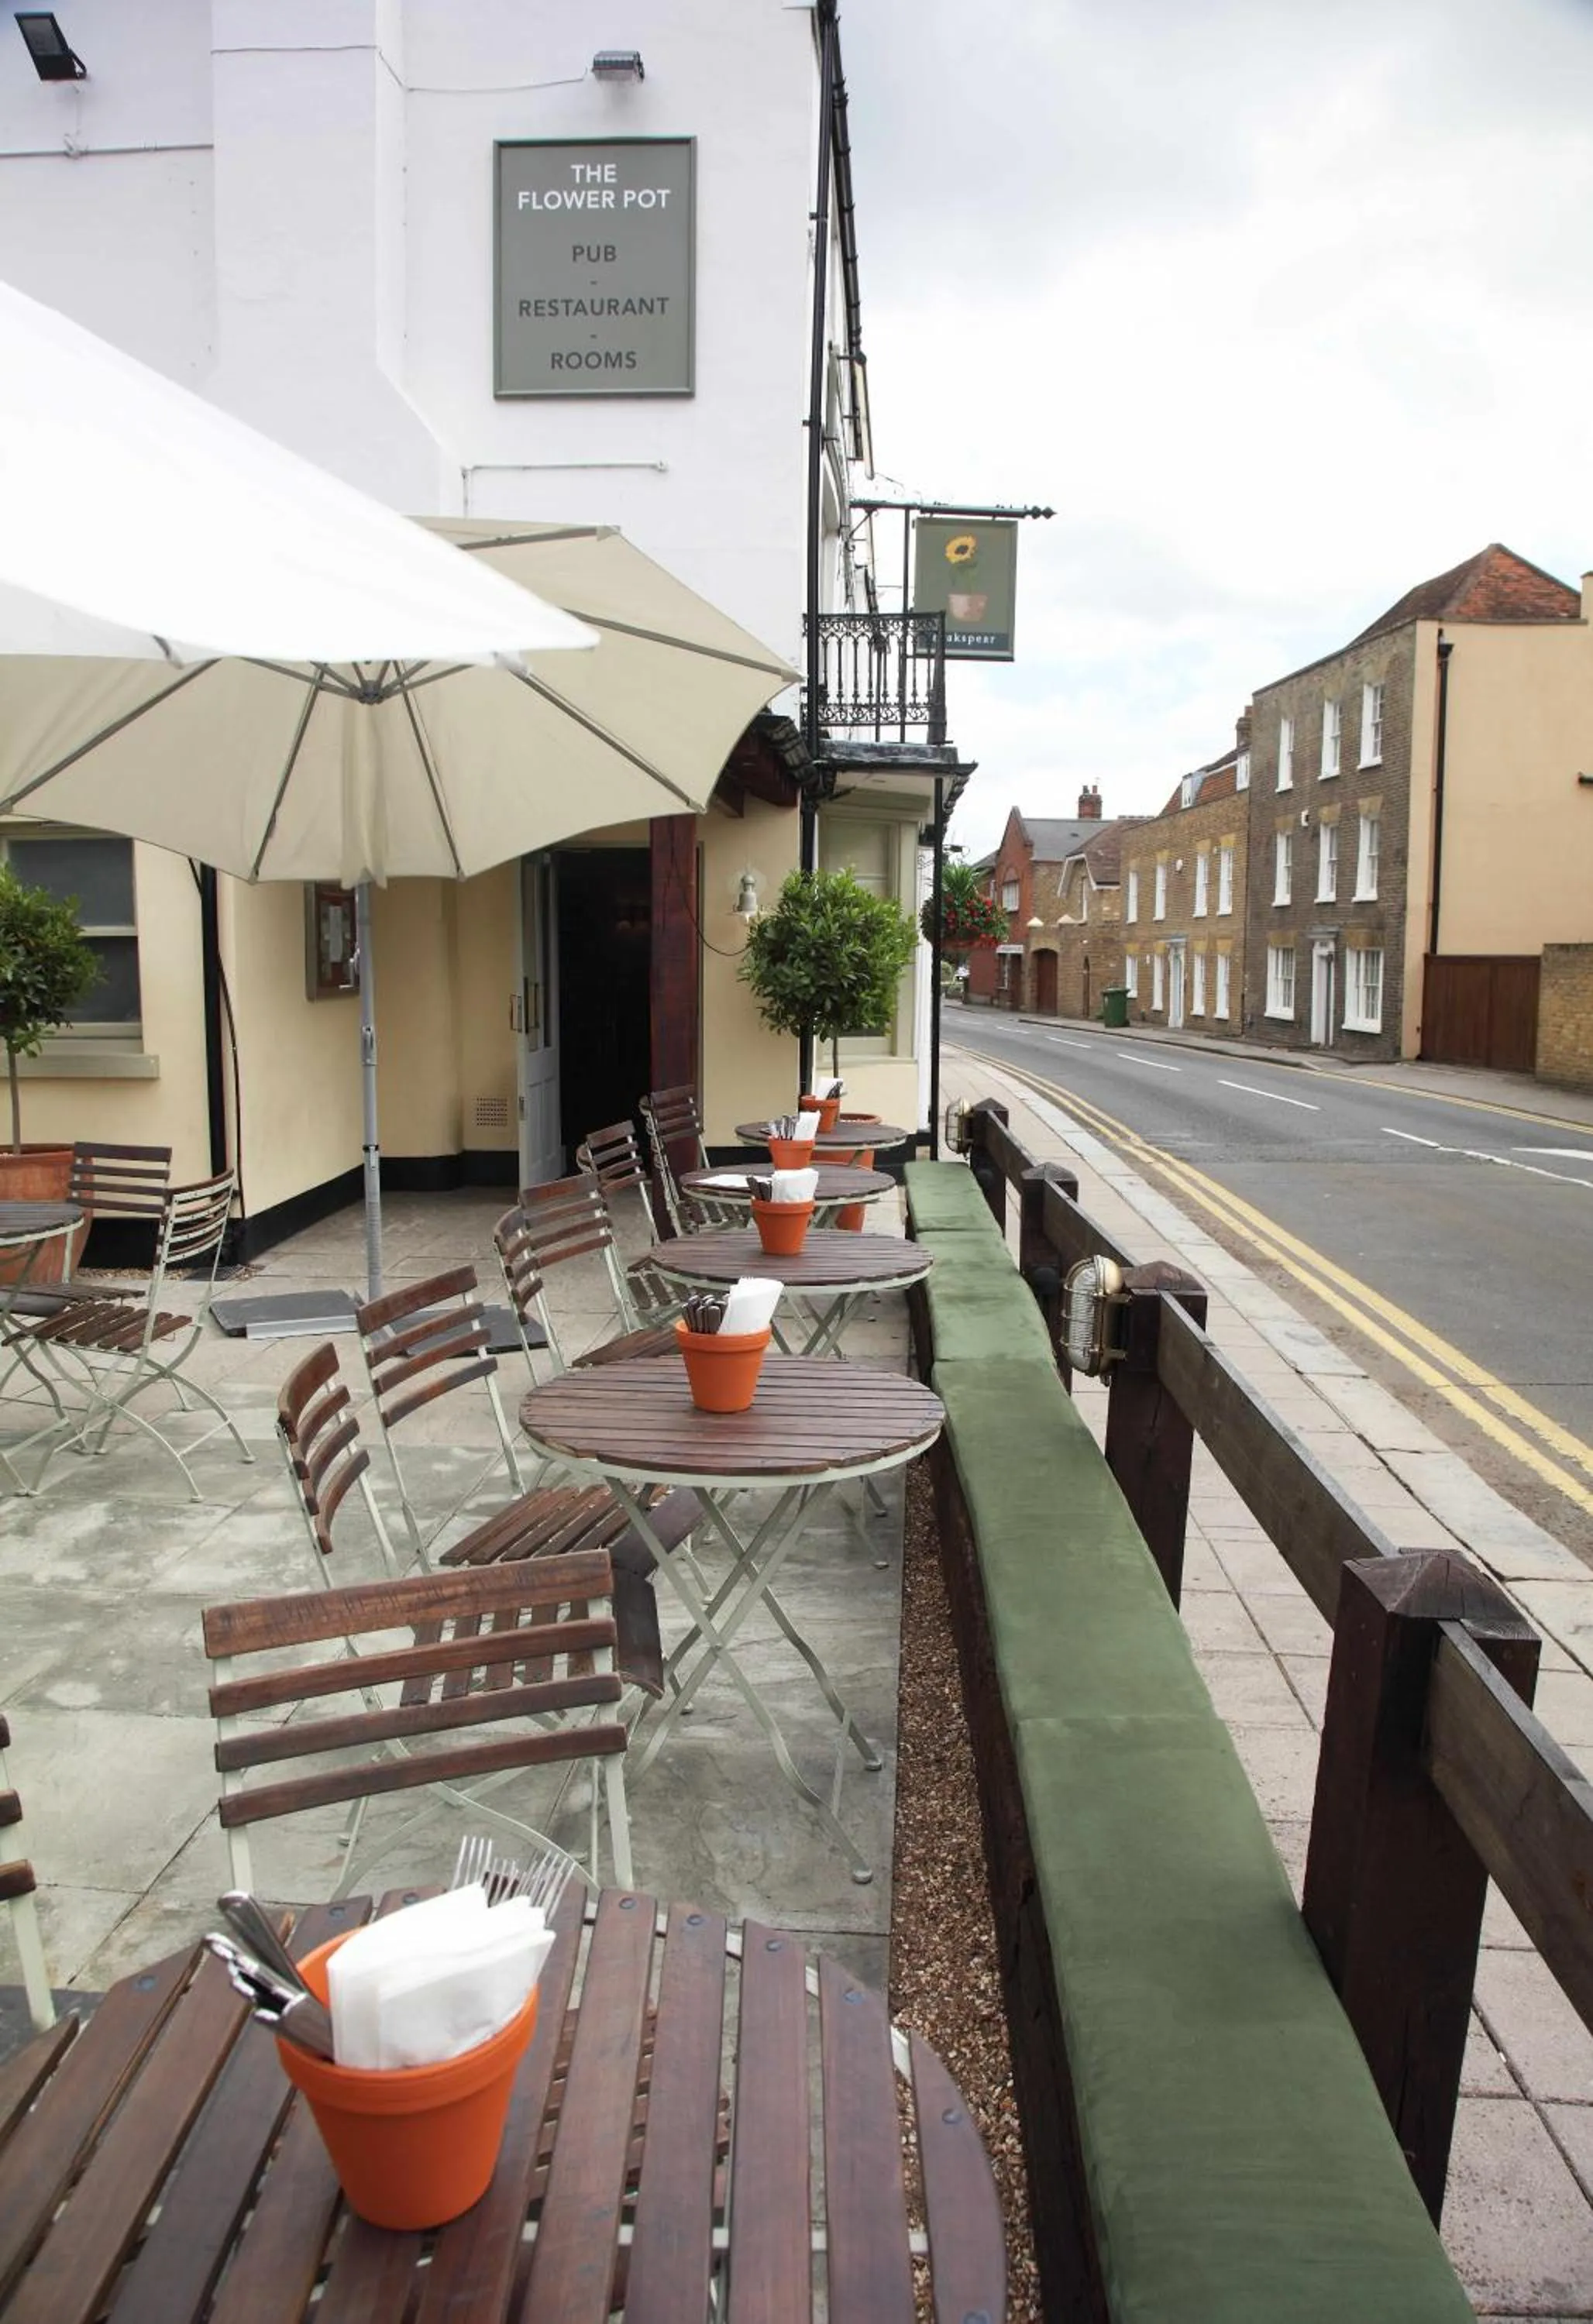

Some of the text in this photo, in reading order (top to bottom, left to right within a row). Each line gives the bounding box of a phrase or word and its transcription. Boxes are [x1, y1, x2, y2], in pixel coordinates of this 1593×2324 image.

[570, 163, 618, 184] THE
[518, 189, 671, 210] FLOWER POT
[572, 244, 617, 263] PUB
[518, 297, 669, 318] RESTAURANT
[551, 351, 637, 370] ROOMS
[932, 632, 996, 645] akspear
